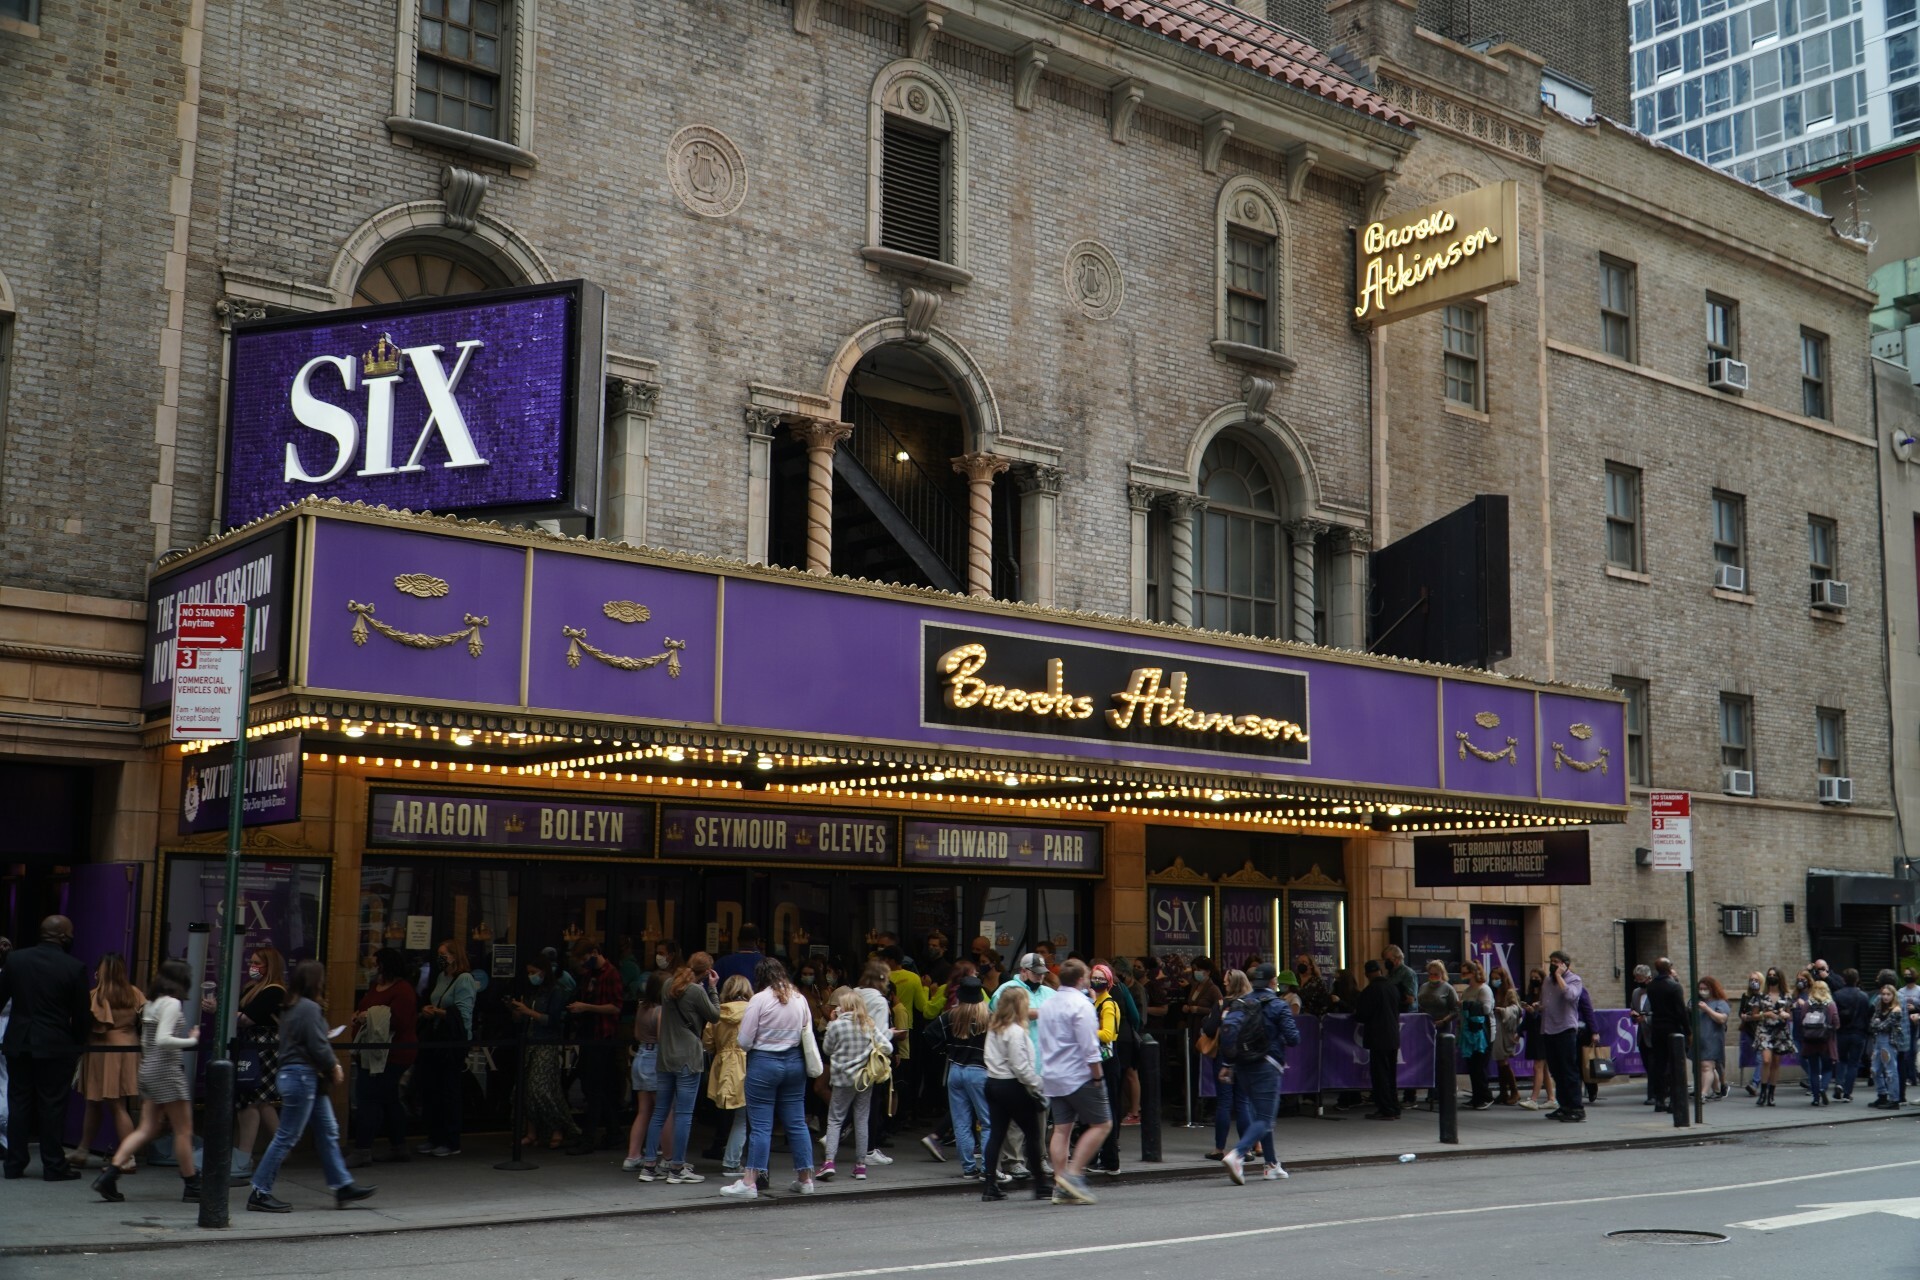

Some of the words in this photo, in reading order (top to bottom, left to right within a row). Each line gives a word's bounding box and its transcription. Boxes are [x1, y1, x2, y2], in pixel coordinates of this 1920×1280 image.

[1363, 210, 1455, 254] Brooks
[1355, 227, 1498, 317] Atkinson
[157, 594, 175, 633] THE
[215, 554, 272, 604] SENSATION
[182, 608, 194, 616] NO
[196, 608, 235, 617] STANDING
[182, 619, 214, 628] Anytime
[181, 650, 192, 667] 3
[178, 676, 224, 685] COMMERCIAL
[178, 686, 212, 694] VEHICLES
[213, 686, 232, 694] ONLY
[937, 643, 1093, 720] Brooks
[1105, 667, 1310, 742] Atkinson
[176, 715, 199, 723] Except
[200, 715, 220, 723] Sunday
[195, 706, 221, 714] Midnight
[220, 760, 256, 798] TOLY
[392, 800, 488, 836] ARAGON
[540, 808, 624, 842] BOLEYN
[1654, 819, 1661, 829] 3
[694, 816, 787, 849] SEYMOUR
[819, 822, 886, 853] CLEVES
[938, 828, 1008, 858] HOWARD
[1044, 834, 1083, 862] PARR
[1468, 840, 1512, 856] BROADWAY
[1513, 839, 1544, 854] SEASON
[1453, 858, 1471, 874] GOT
[1156, 899, 1199, 932] SIX
[1223, 904, 1270, 923] ARAGON
[1225, 928, 1270, 946] BOLEYN
[1471, 943, 1519, 990] IX
[1617, 1017, 1640, 1054] SI
